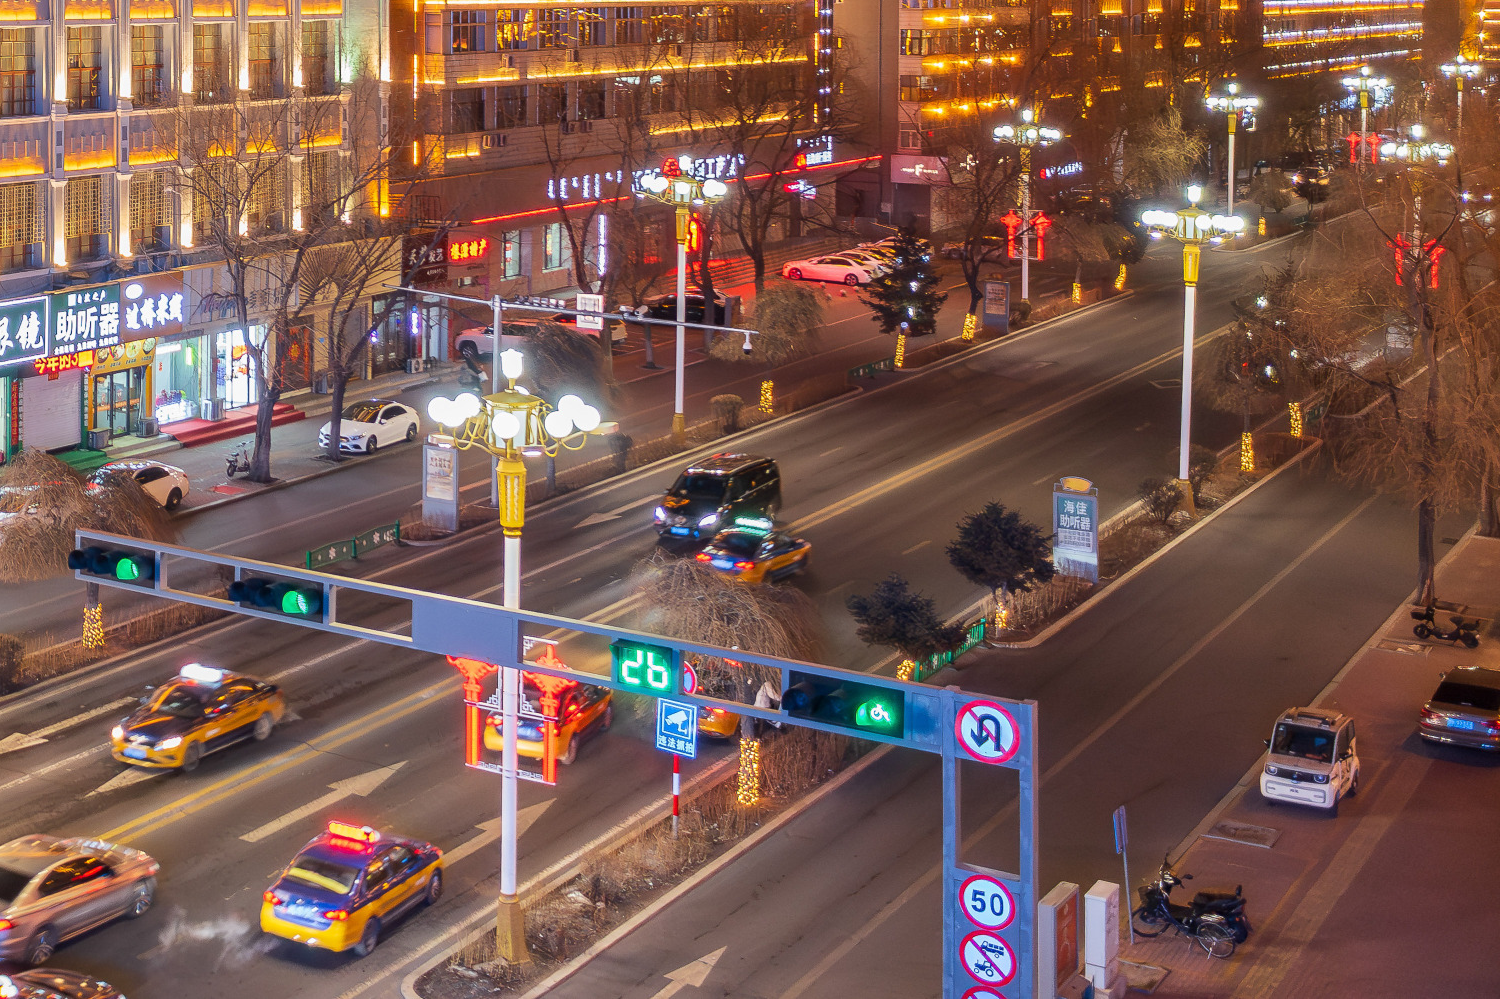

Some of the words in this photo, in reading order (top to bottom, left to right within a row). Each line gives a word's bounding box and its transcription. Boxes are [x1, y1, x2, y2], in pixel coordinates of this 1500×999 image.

[55, 302, 120, 342] 助听器
[1063, 500, 1087, 515] 海佳
[1060, 514, 1091, 531] 助听器
[621, 649, 668, 689] 26
[658, 735, 694, 754] 违法抓拍
[971, 889, 1004, 917] 50
